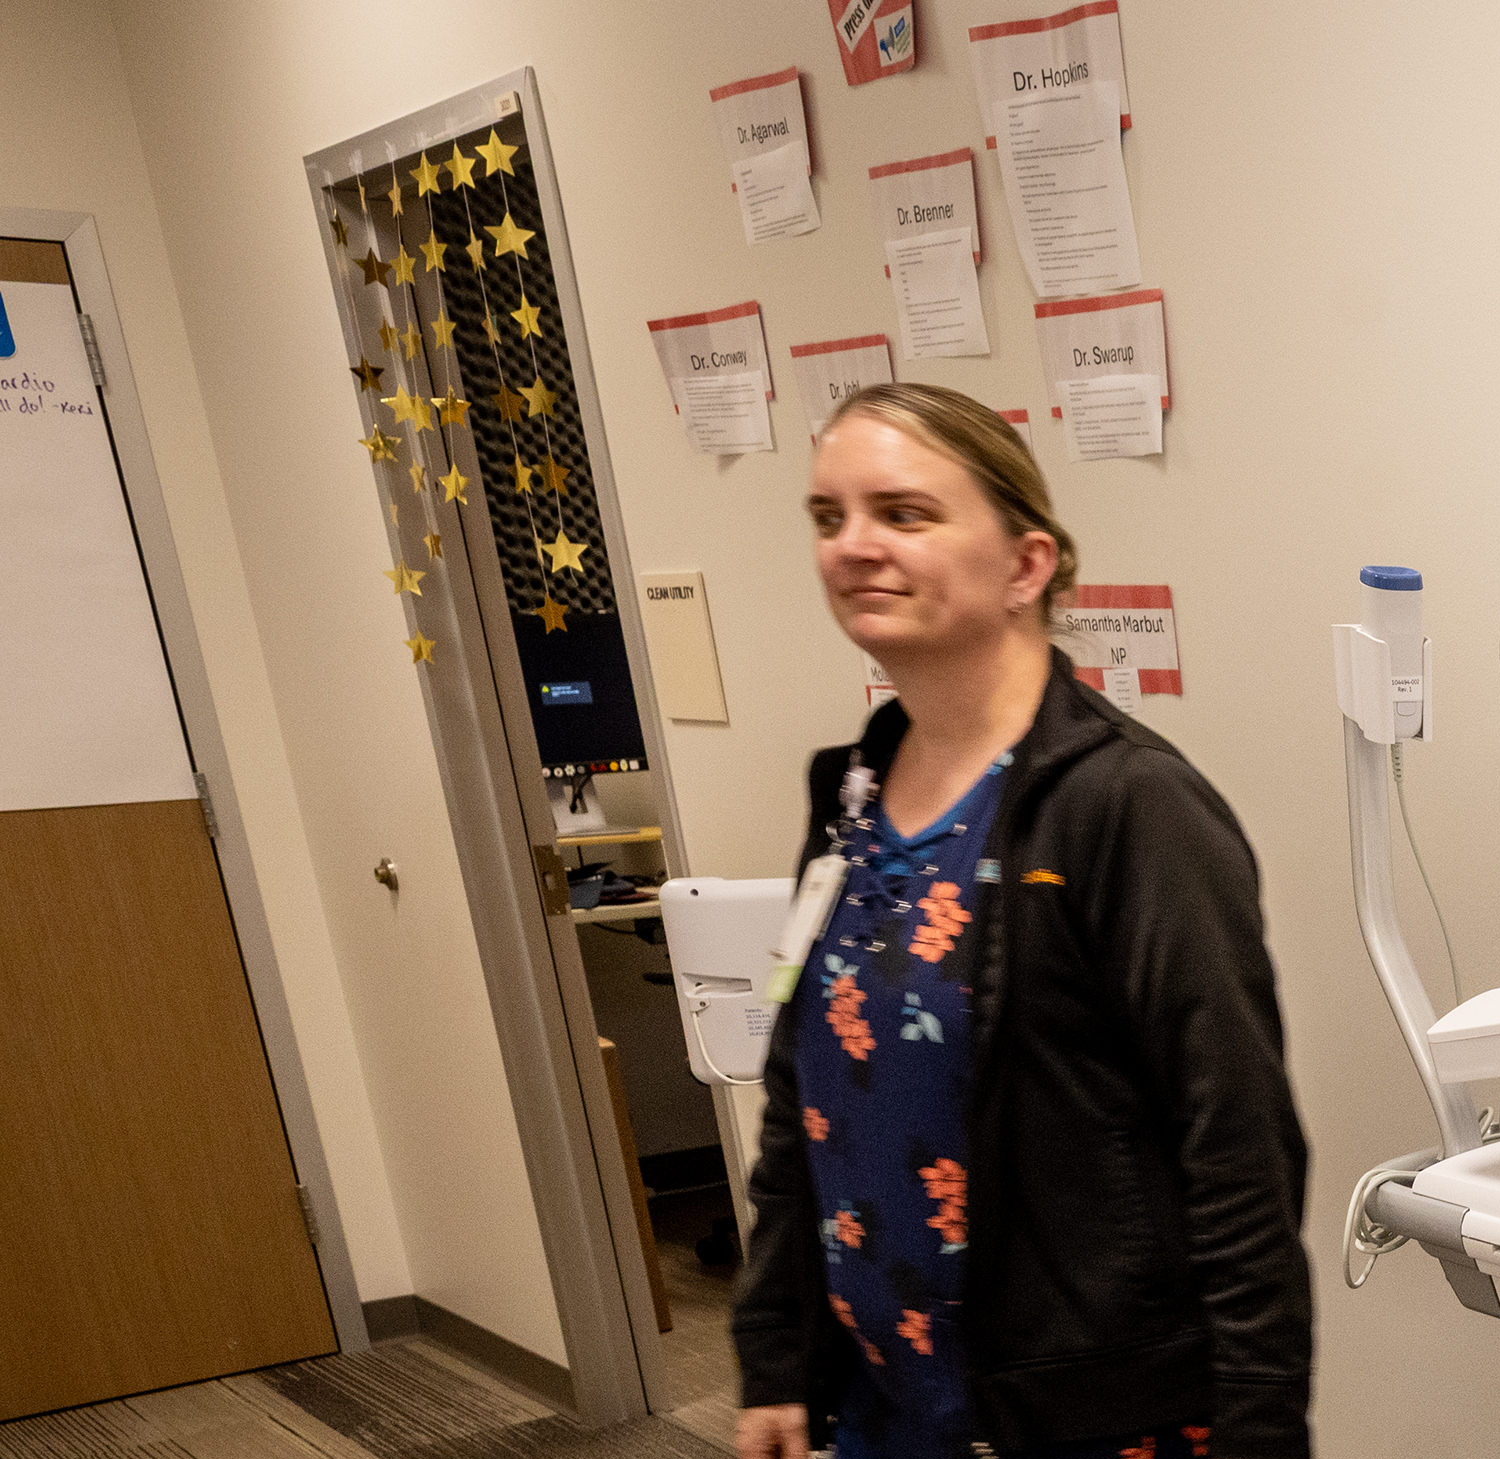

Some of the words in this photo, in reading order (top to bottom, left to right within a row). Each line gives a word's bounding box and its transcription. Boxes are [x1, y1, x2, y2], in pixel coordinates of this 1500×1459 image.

[1013, 71, 1037, 92] Dr.
[1042, 61, 1089, 89] Hopkins
[737, 126, 751, 144] Dr.
[751, 117, 789, 144] Agarwal
[897, 207, 911, 225] Dr.
[913, 203, 954, 222] Brenner
[690, 353, 708, 371] Dr.
[711, 348, 747, 370] Conway
[1073, 348, 1091, 367] Dr.
[1093, 345, 1134, 367] Swarup
[829, 383, 842, 399] Dr.
[646, 586, 670, 599] CLEAN
[671, 585, 694, 599] UTILITY
[1065, 613, 1120, 634] Samantha
[1122, 613, 1164, 634] Marbut
[1111, 647, 1127, 665] NP
